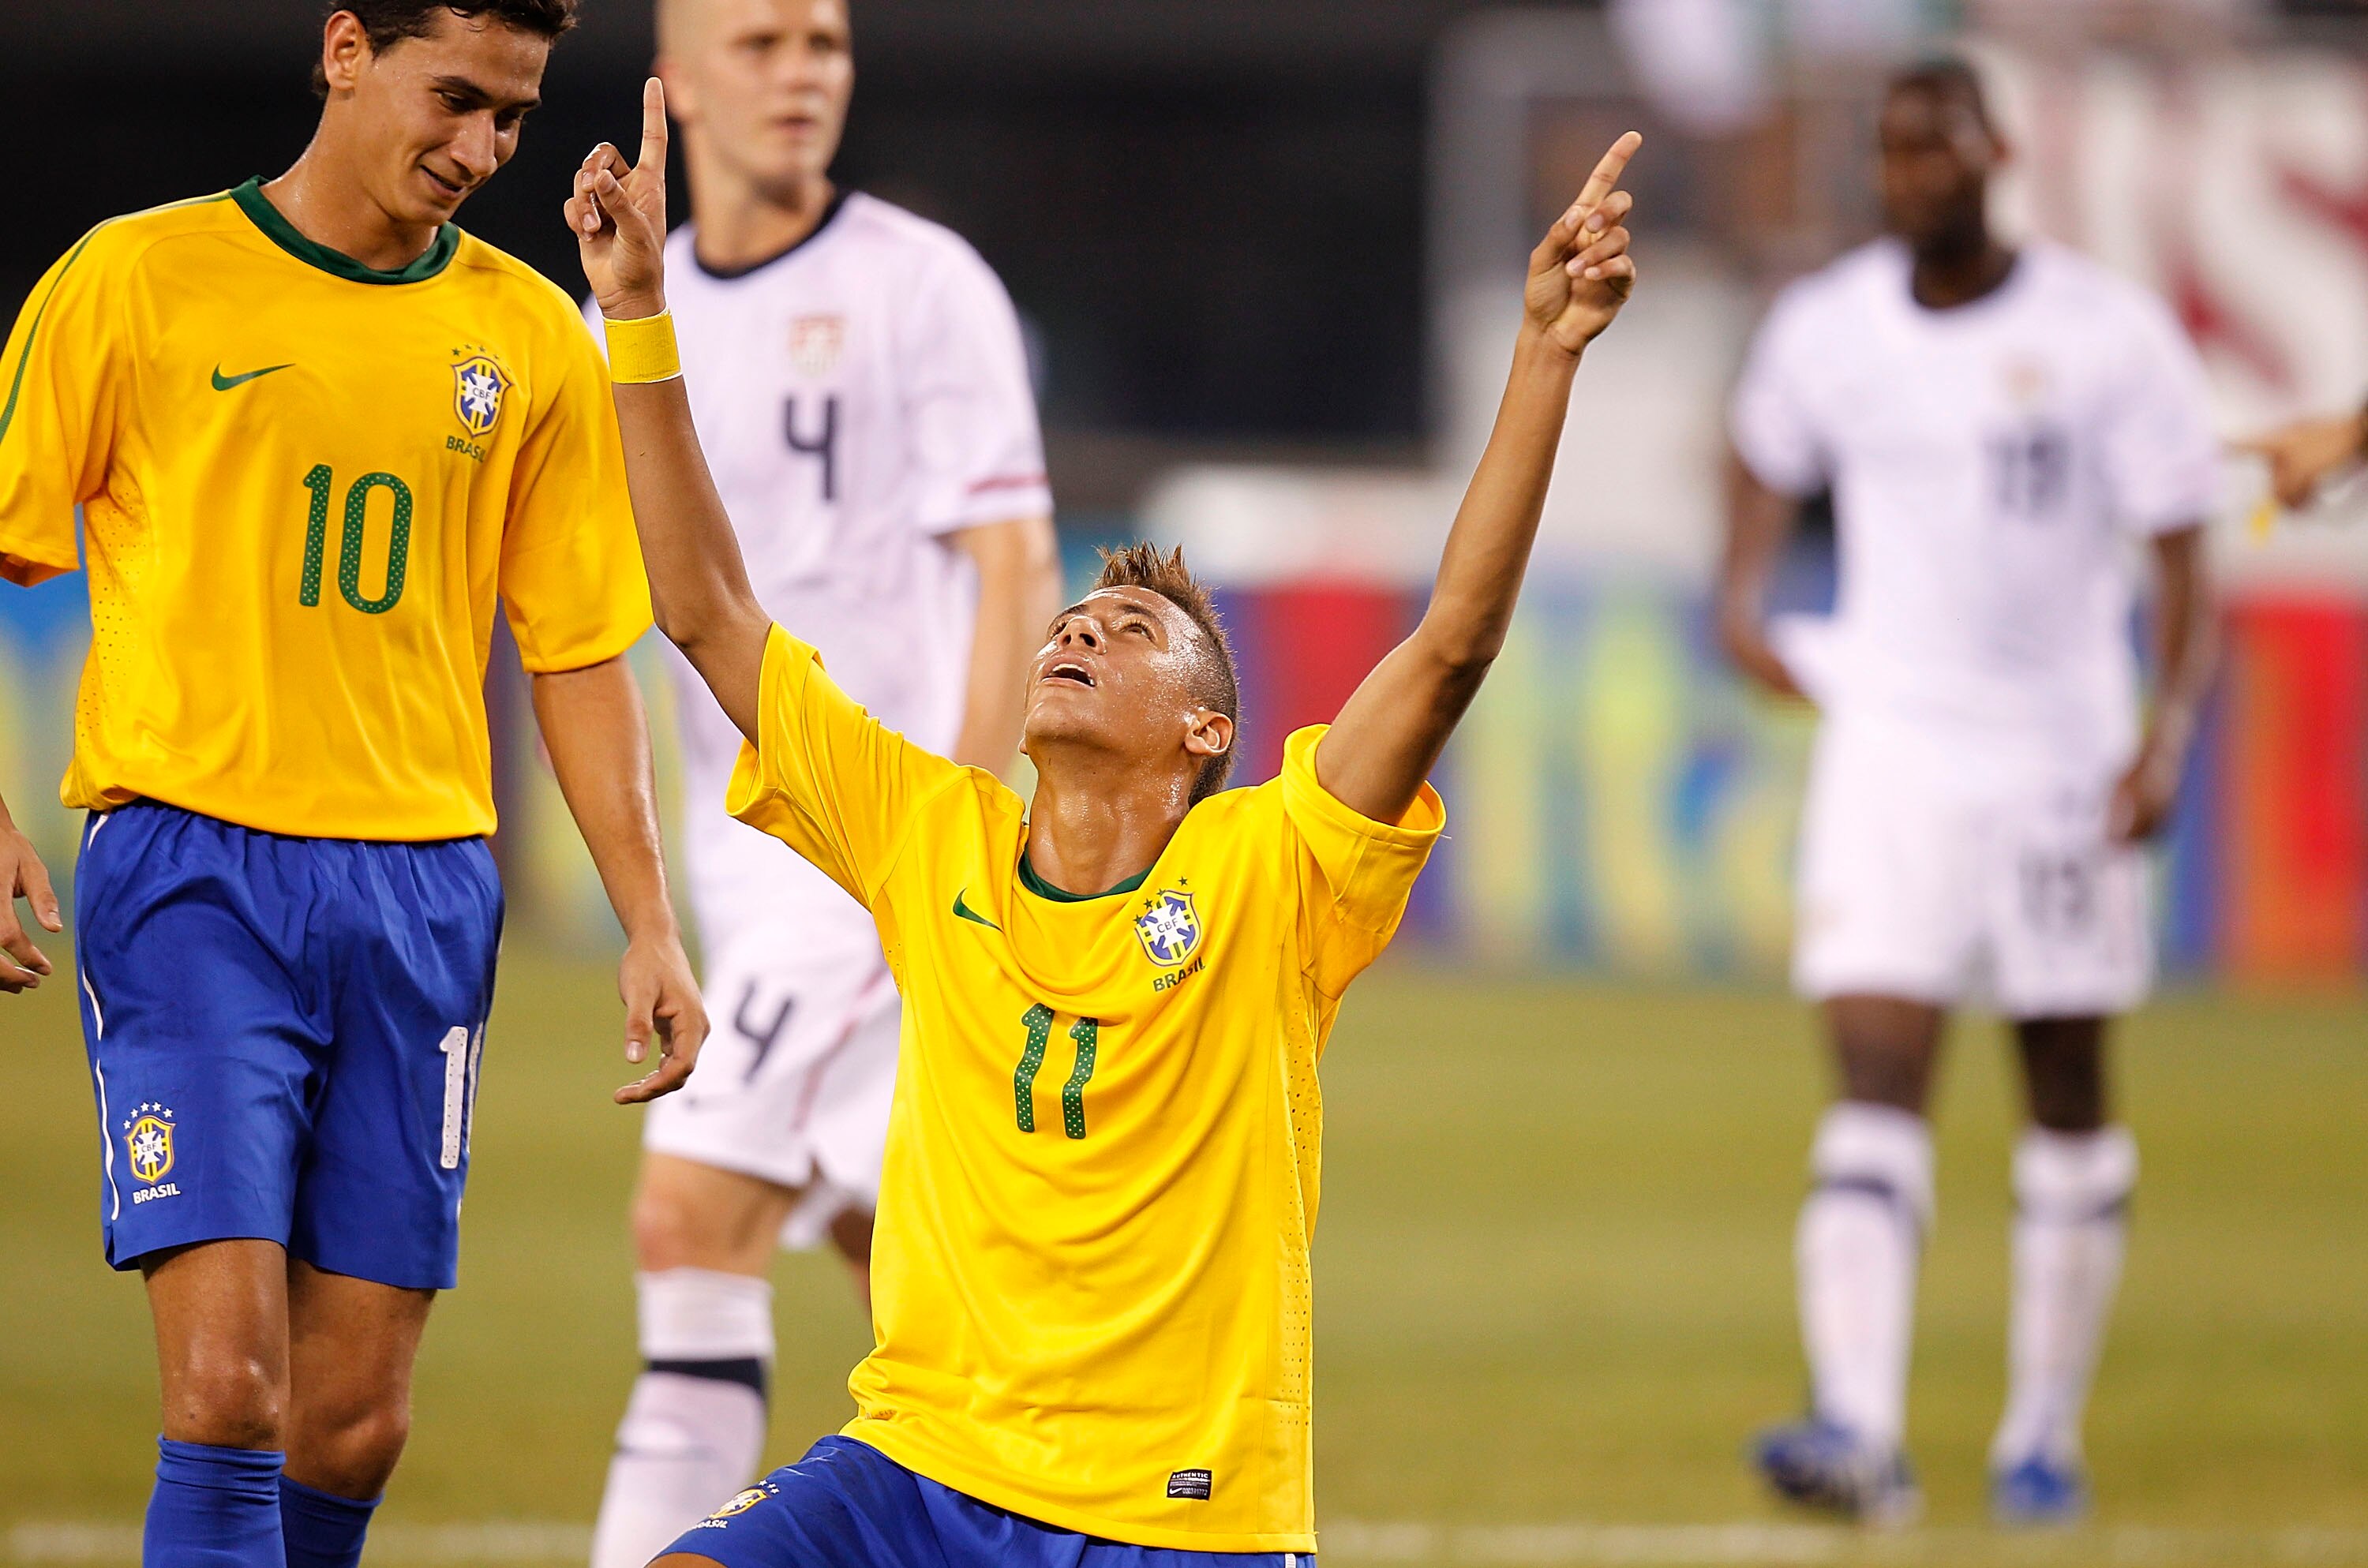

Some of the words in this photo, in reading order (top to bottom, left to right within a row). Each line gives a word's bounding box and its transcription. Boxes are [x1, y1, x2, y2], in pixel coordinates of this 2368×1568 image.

[473, 387, 491, 400] CBF
[781, 393, 838, 503] 4
[299, 463, 413, 614] 10
[1157, 918, 1178, 933] CBF
[1152, 956, 1206, 992] BRASIL
[733, 976, 796, 1086] 4
[1014, 1002, 1098, 1140] 11
[141, 1143, 157, 1153] CBF
[133, 1183, 181, 1204] BRASIL
